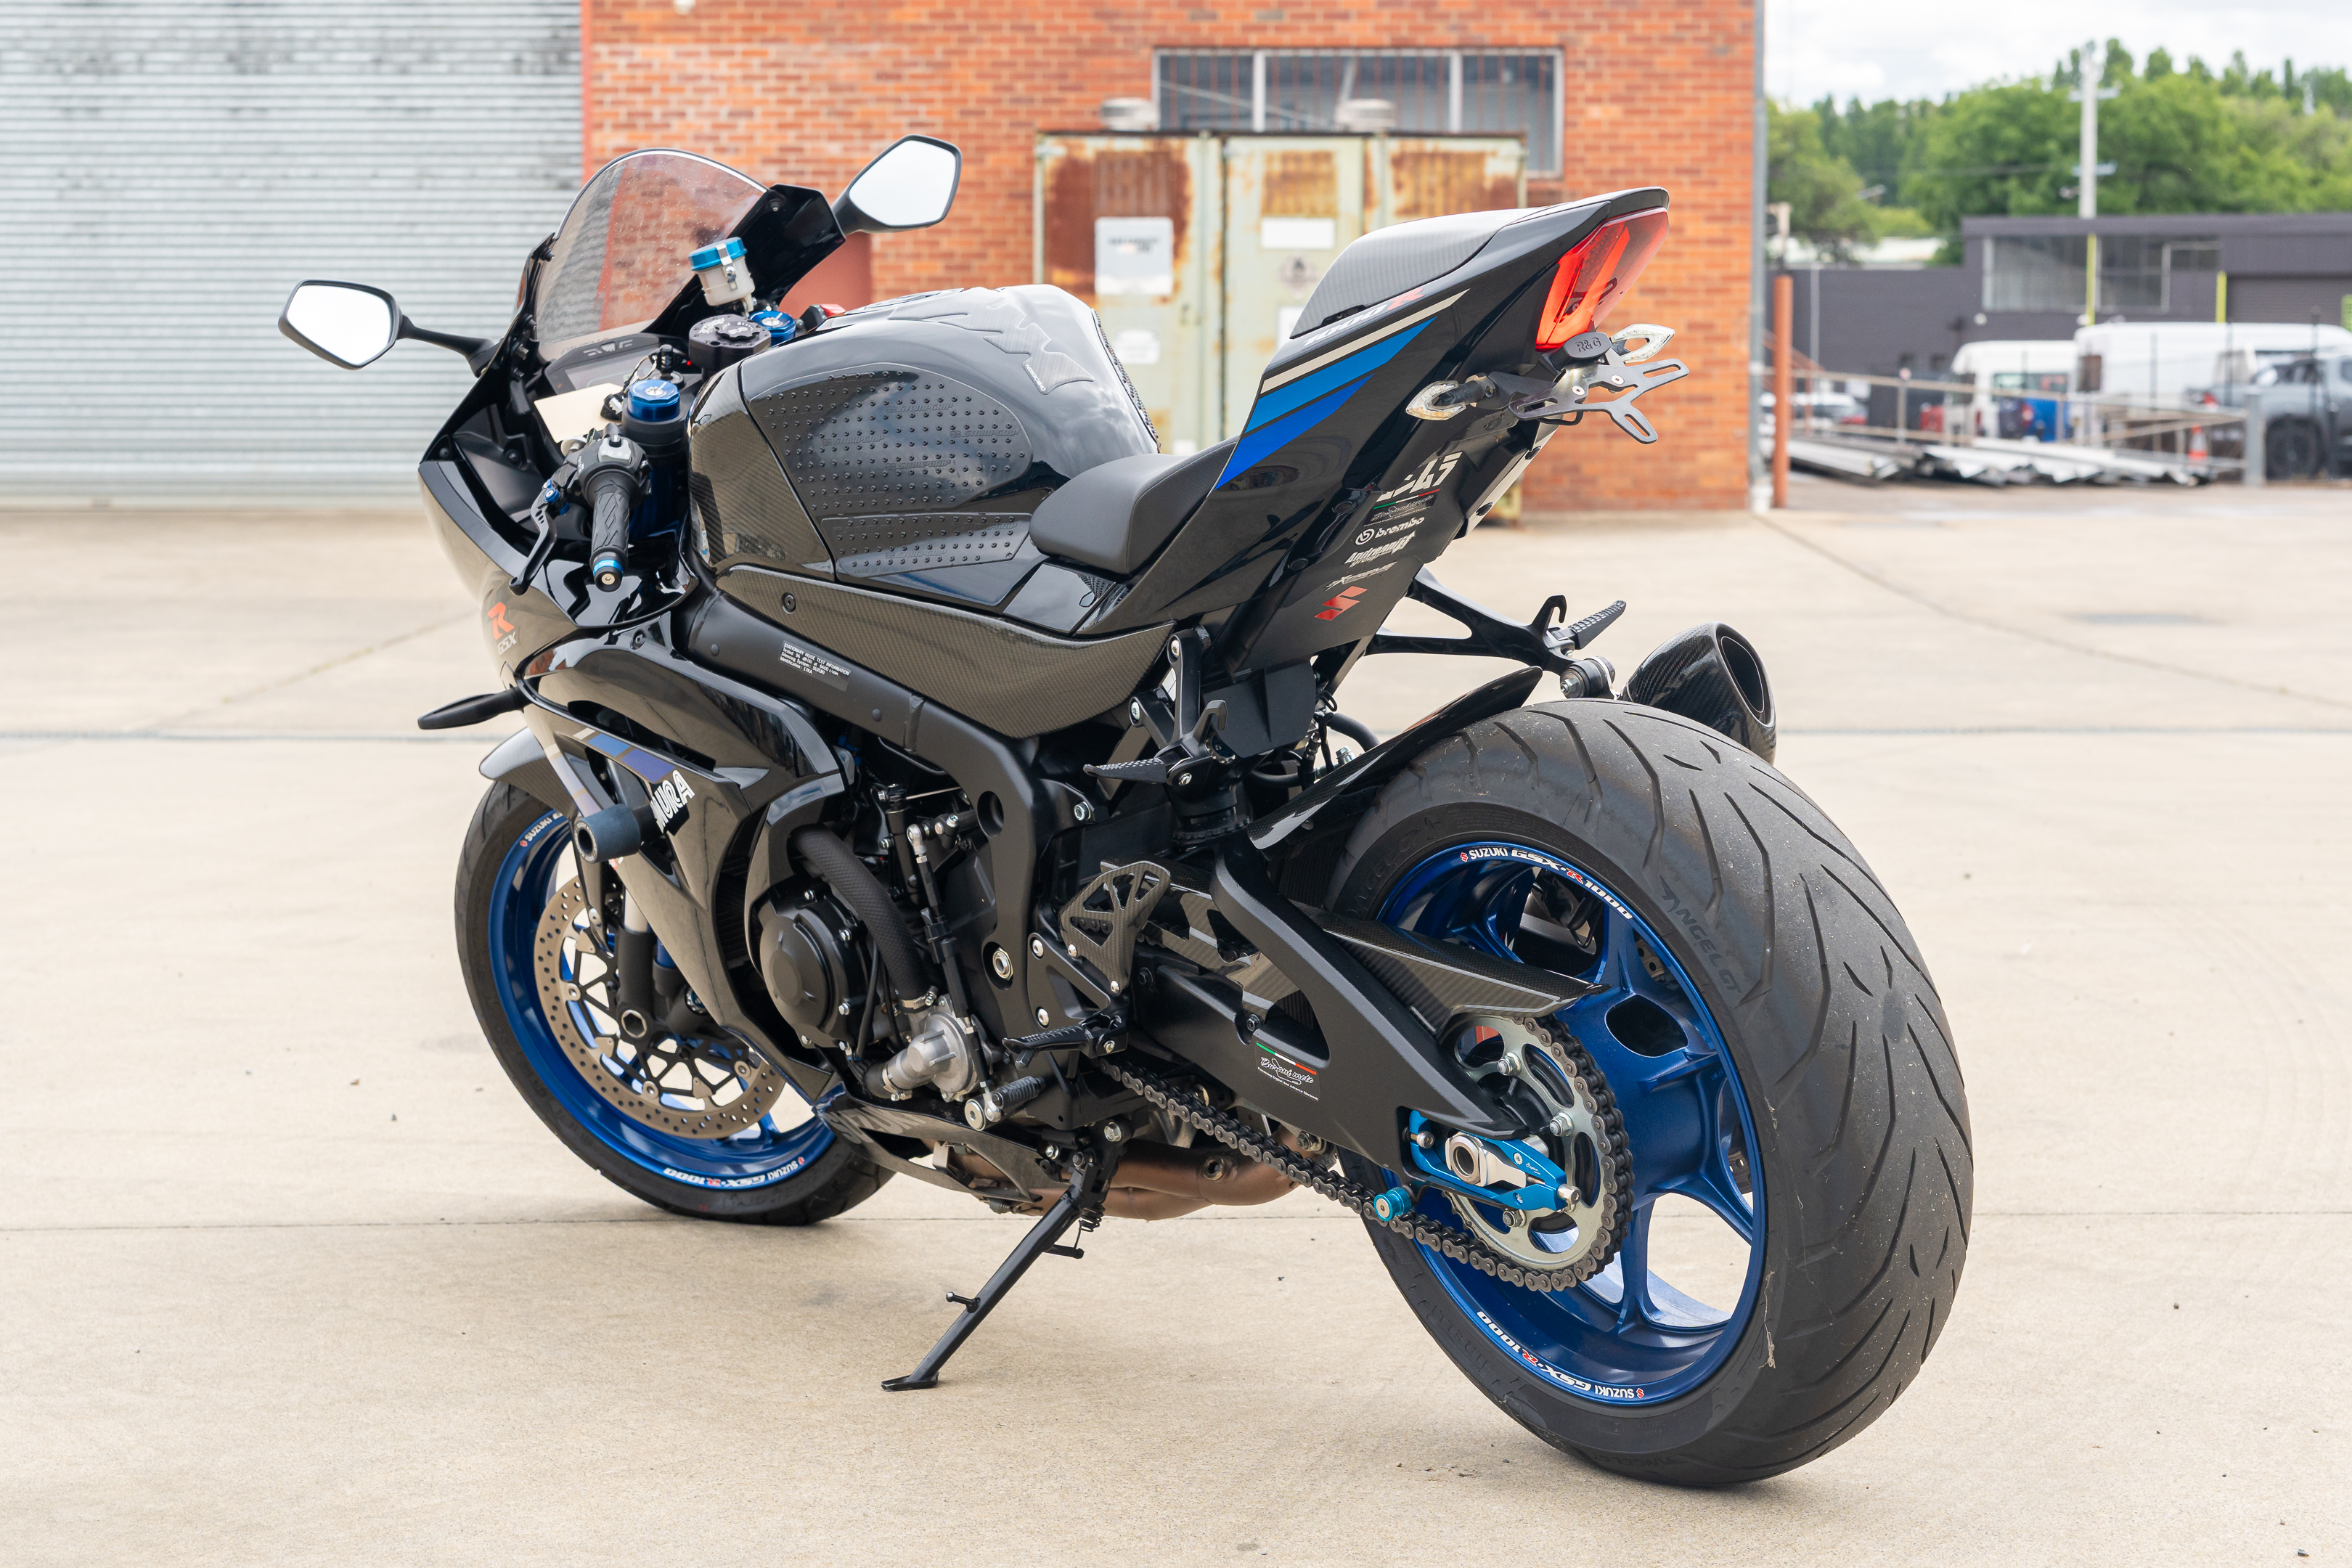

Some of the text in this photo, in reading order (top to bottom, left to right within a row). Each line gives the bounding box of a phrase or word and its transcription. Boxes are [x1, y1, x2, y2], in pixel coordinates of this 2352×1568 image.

[1575, 337, 1602, 353] R&G
[1375, 516, 1425, 539] brembo
[497, 631, 518, 656] GSX
[783, 647, 794, 656] Tested
[781, 651, 796, 662] Silencing
[812, 666, 825, 675] SUZUKI
[784, 642, 804, 656] STATIONARY
[805, 652, 815, 661] NOISE
[825, 661, 850, 676] INFORMATION
[524, 817, 552, 842] SUZUKI
[1469, 847, 1508, 860] SUZUKI
[767, 1160, 799, 1181] SUZUKI
[1595, 1384, 1635, 1399] SUZUKI
